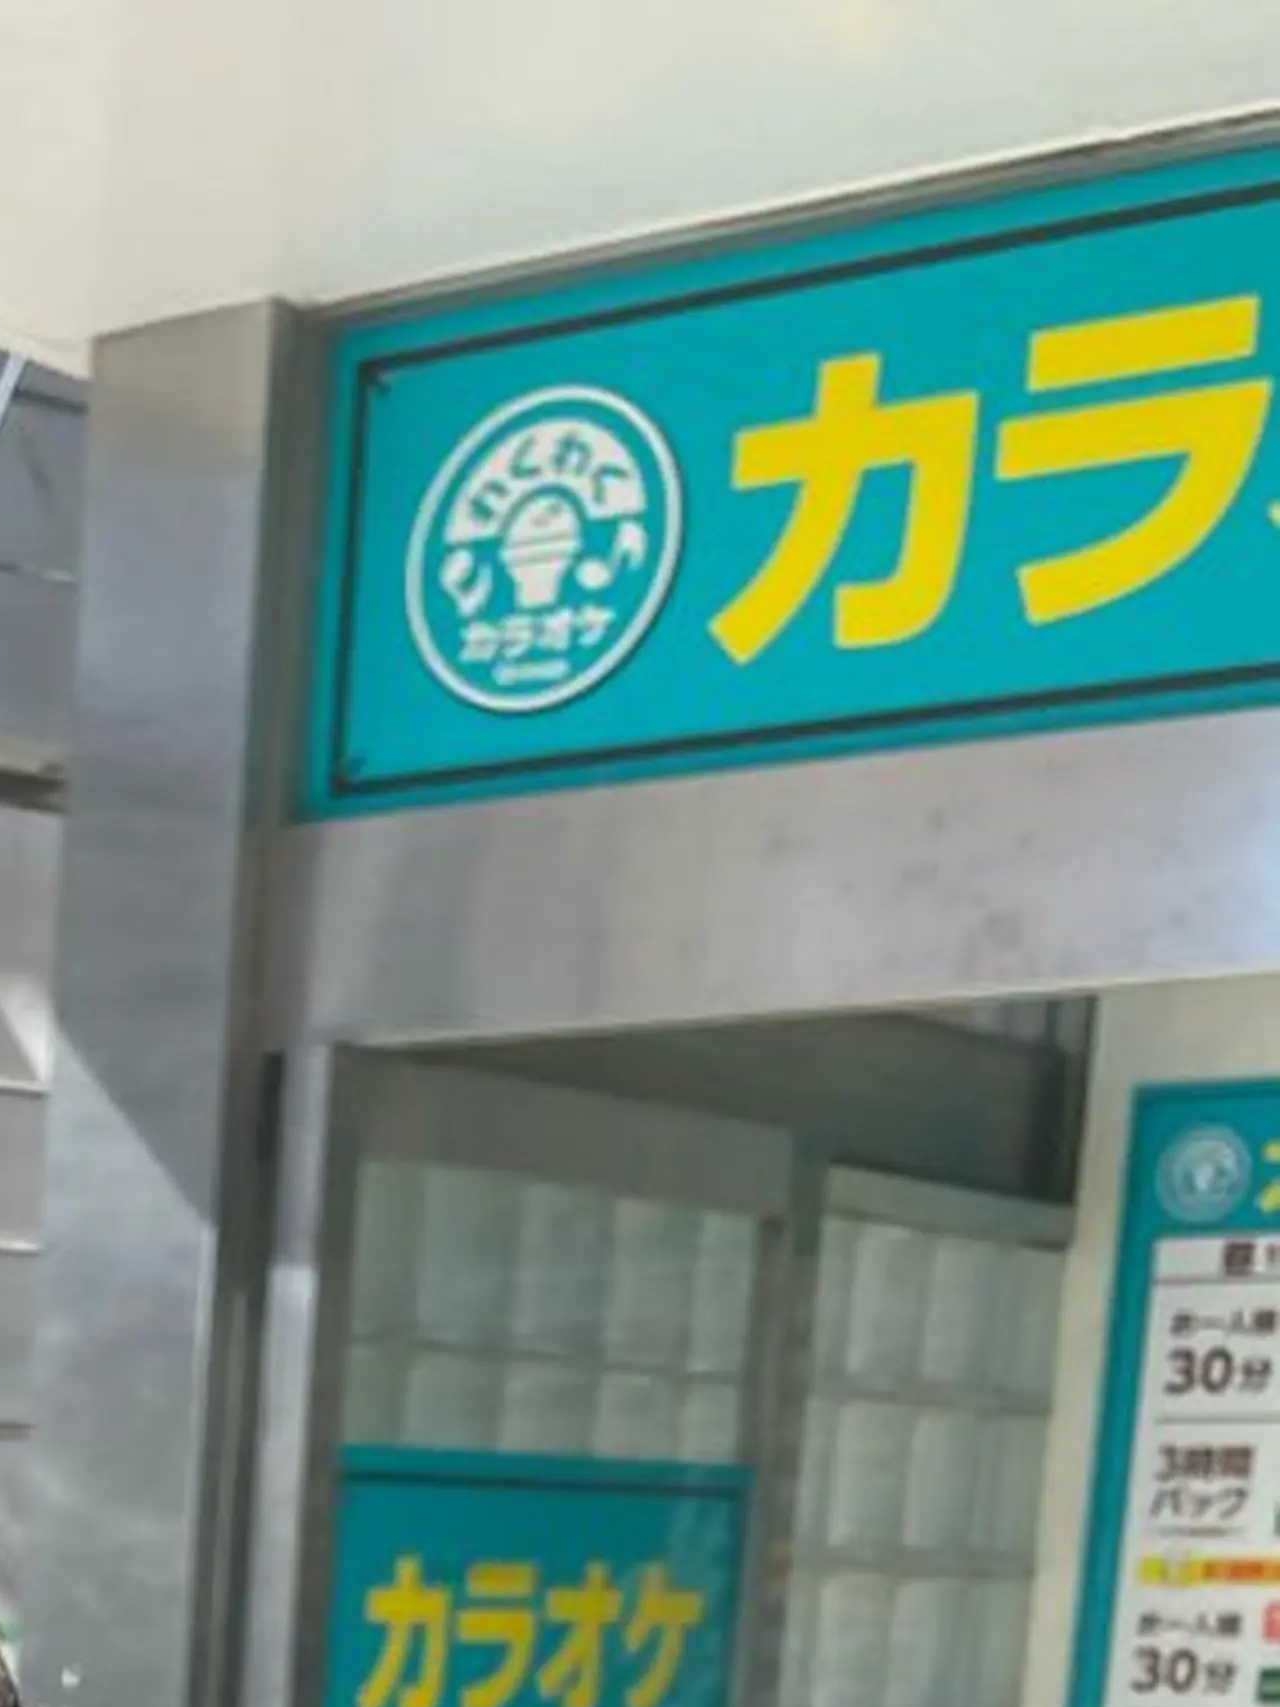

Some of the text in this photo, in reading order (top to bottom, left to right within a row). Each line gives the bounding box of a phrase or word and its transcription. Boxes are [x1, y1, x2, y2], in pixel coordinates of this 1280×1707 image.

[467, 430, 631, 523] わくわく
[707, 293, 1280, 664] カラ
[1162, 1346, 1272, 1395] 30分
[1129, 1646, 1236, 1694] 30分
